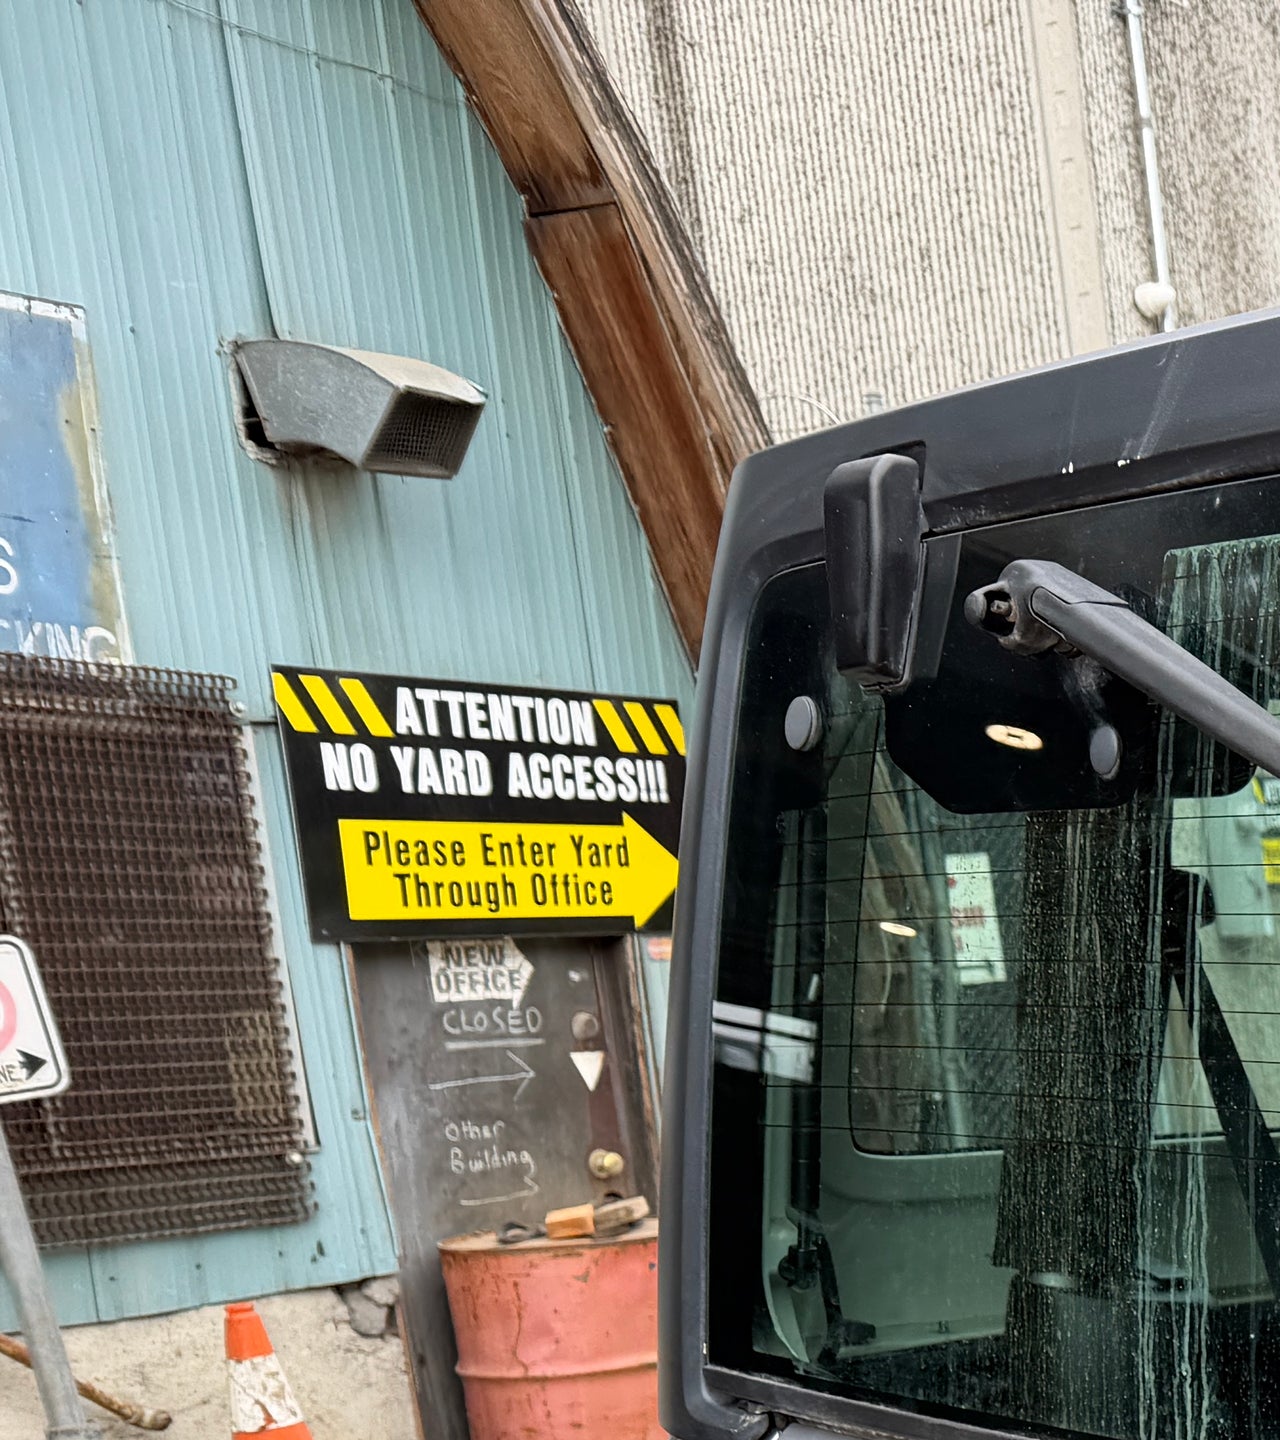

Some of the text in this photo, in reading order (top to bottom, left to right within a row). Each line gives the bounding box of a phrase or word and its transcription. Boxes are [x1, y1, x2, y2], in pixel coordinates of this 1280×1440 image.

[396, 686, 597, 747] ATTENTION
[319, 741, 670, 803] NO YARD ACCESS!!!
[363, 830, 630, 868] Please Enter Yard
[393, 872, 614, 913] Through Office
[441, 943, 504, 967] NEW
[435, 968, 522, 994] OFFICE
[443, 1006, 542, 1034] CLOSED
